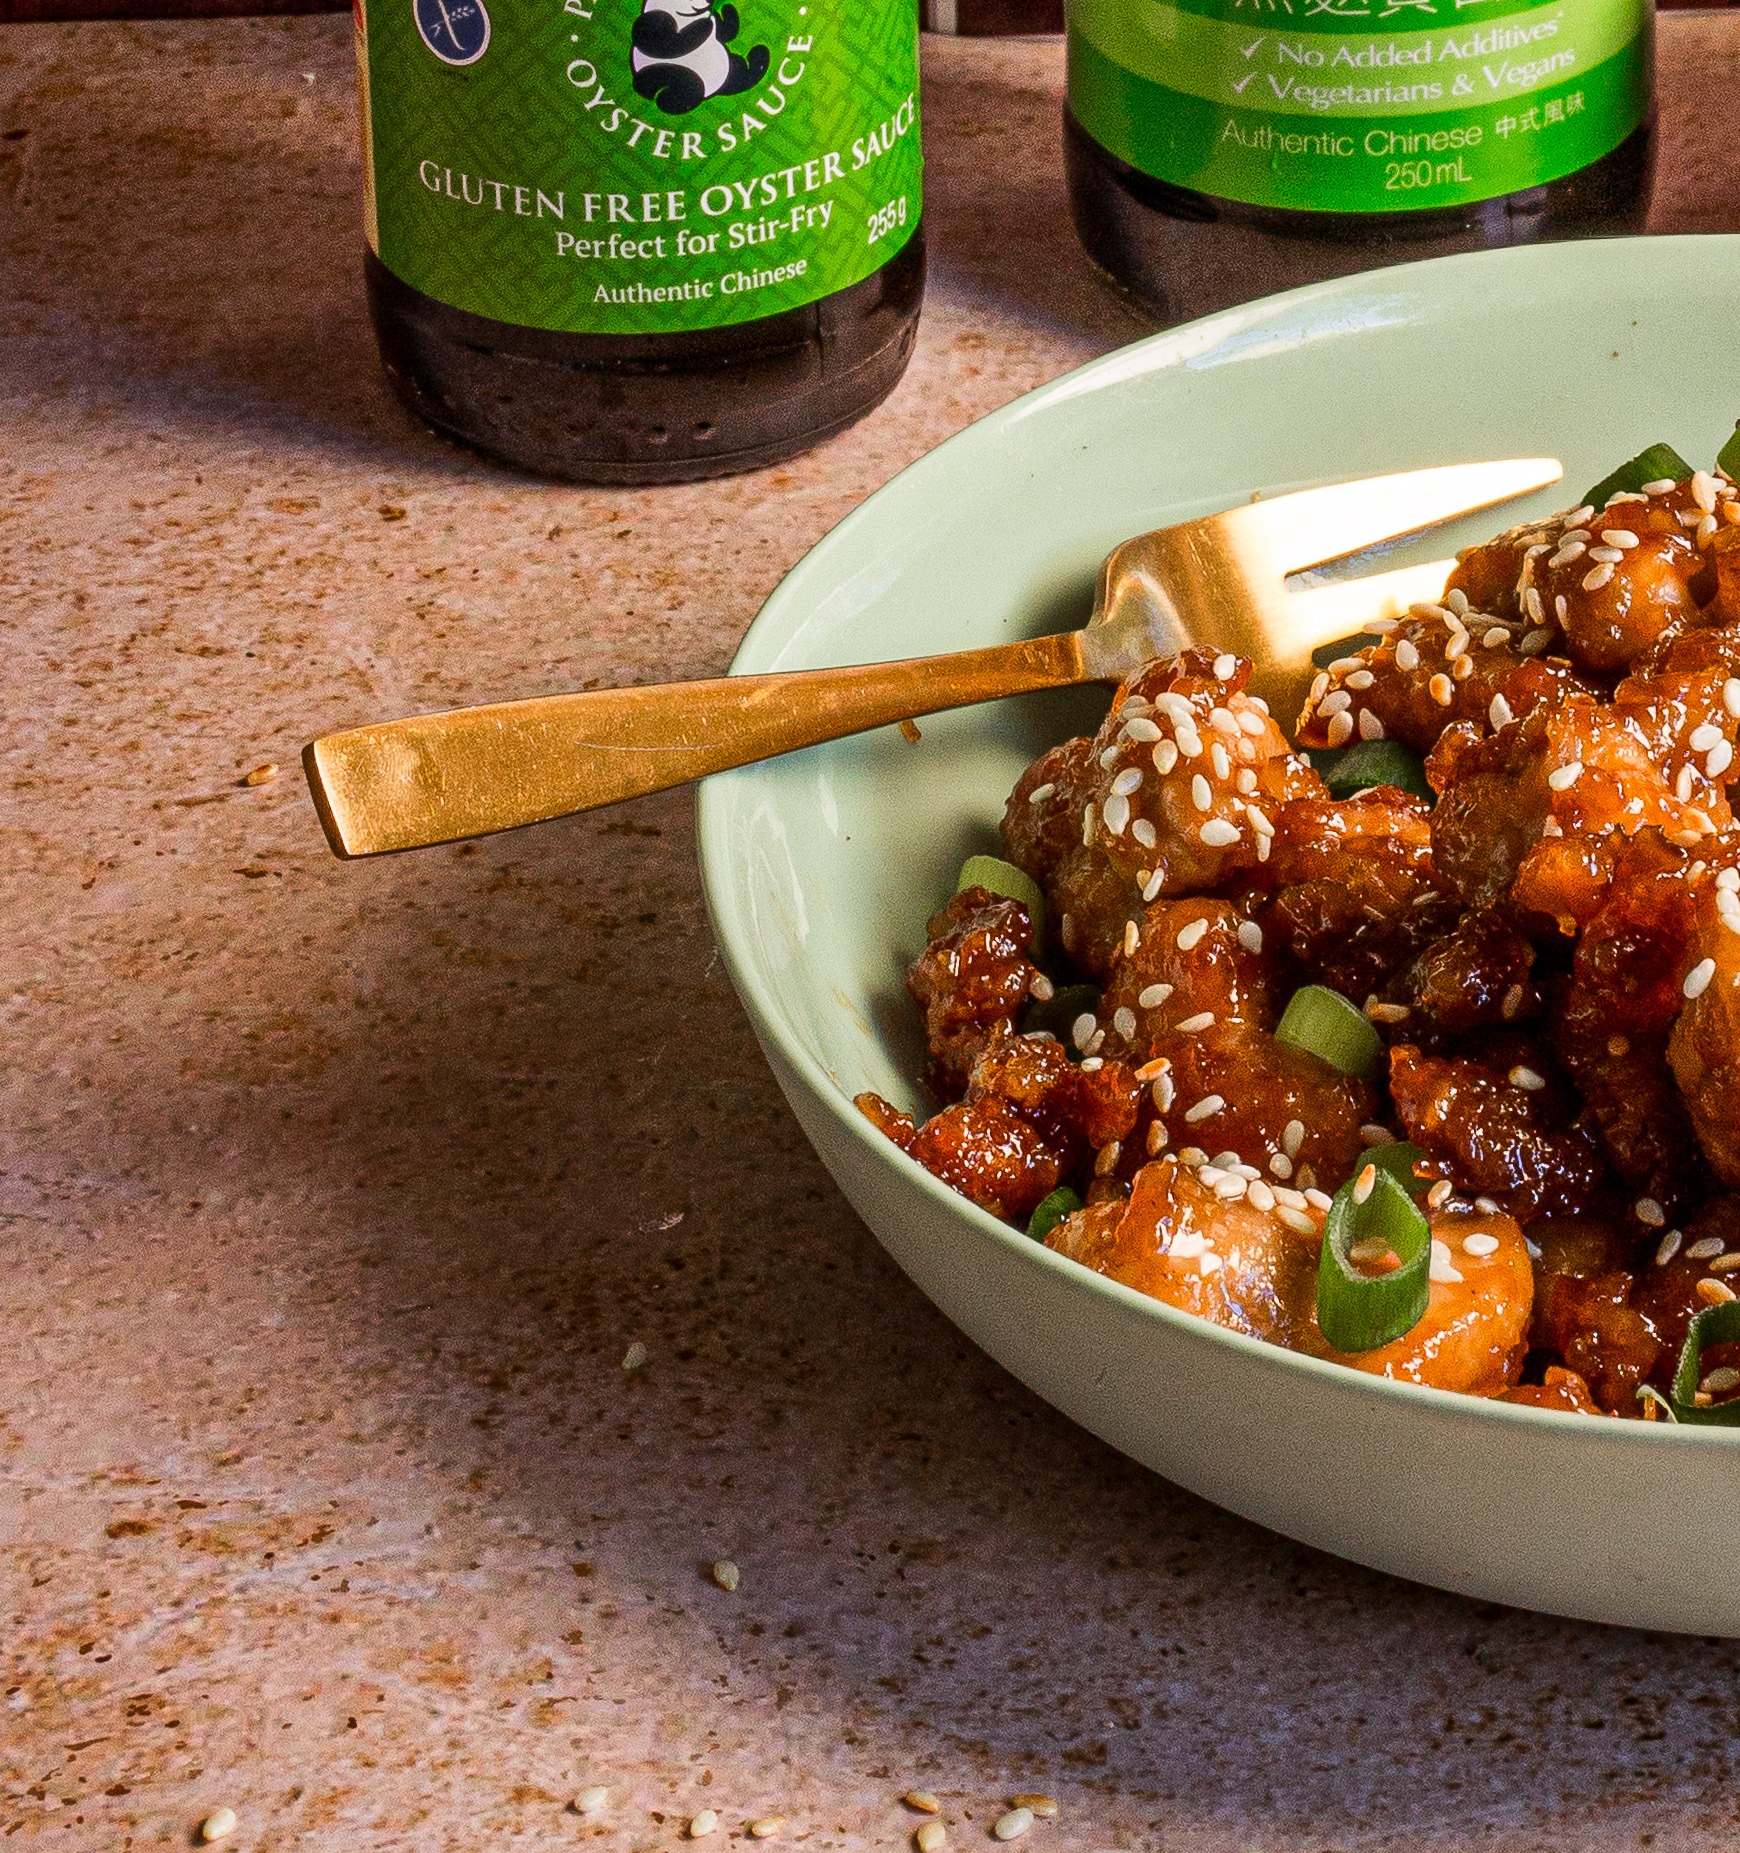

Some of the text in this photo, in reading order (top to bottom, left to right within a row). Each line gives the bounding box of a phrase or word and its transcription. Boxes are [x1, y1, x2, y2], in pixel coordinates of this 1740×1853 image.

[1267, 48, 1576, 111] Vegetarians & Vegans
[1277, 42, 1325, 70] No
[1331, 41, 1432, 68] Added
[566, 34, 813, 160] OYSTER SAUCE
[1221, 90, 1586, 157] Authentic Chinese 中式風味
[419, 93, 915, 224] GLUTEN FREE OYSTER SAUCE
[556, 198, 834, 261] Perfect for Stir-Fry
[593, 258, 808, 304] Authentic Chinese
